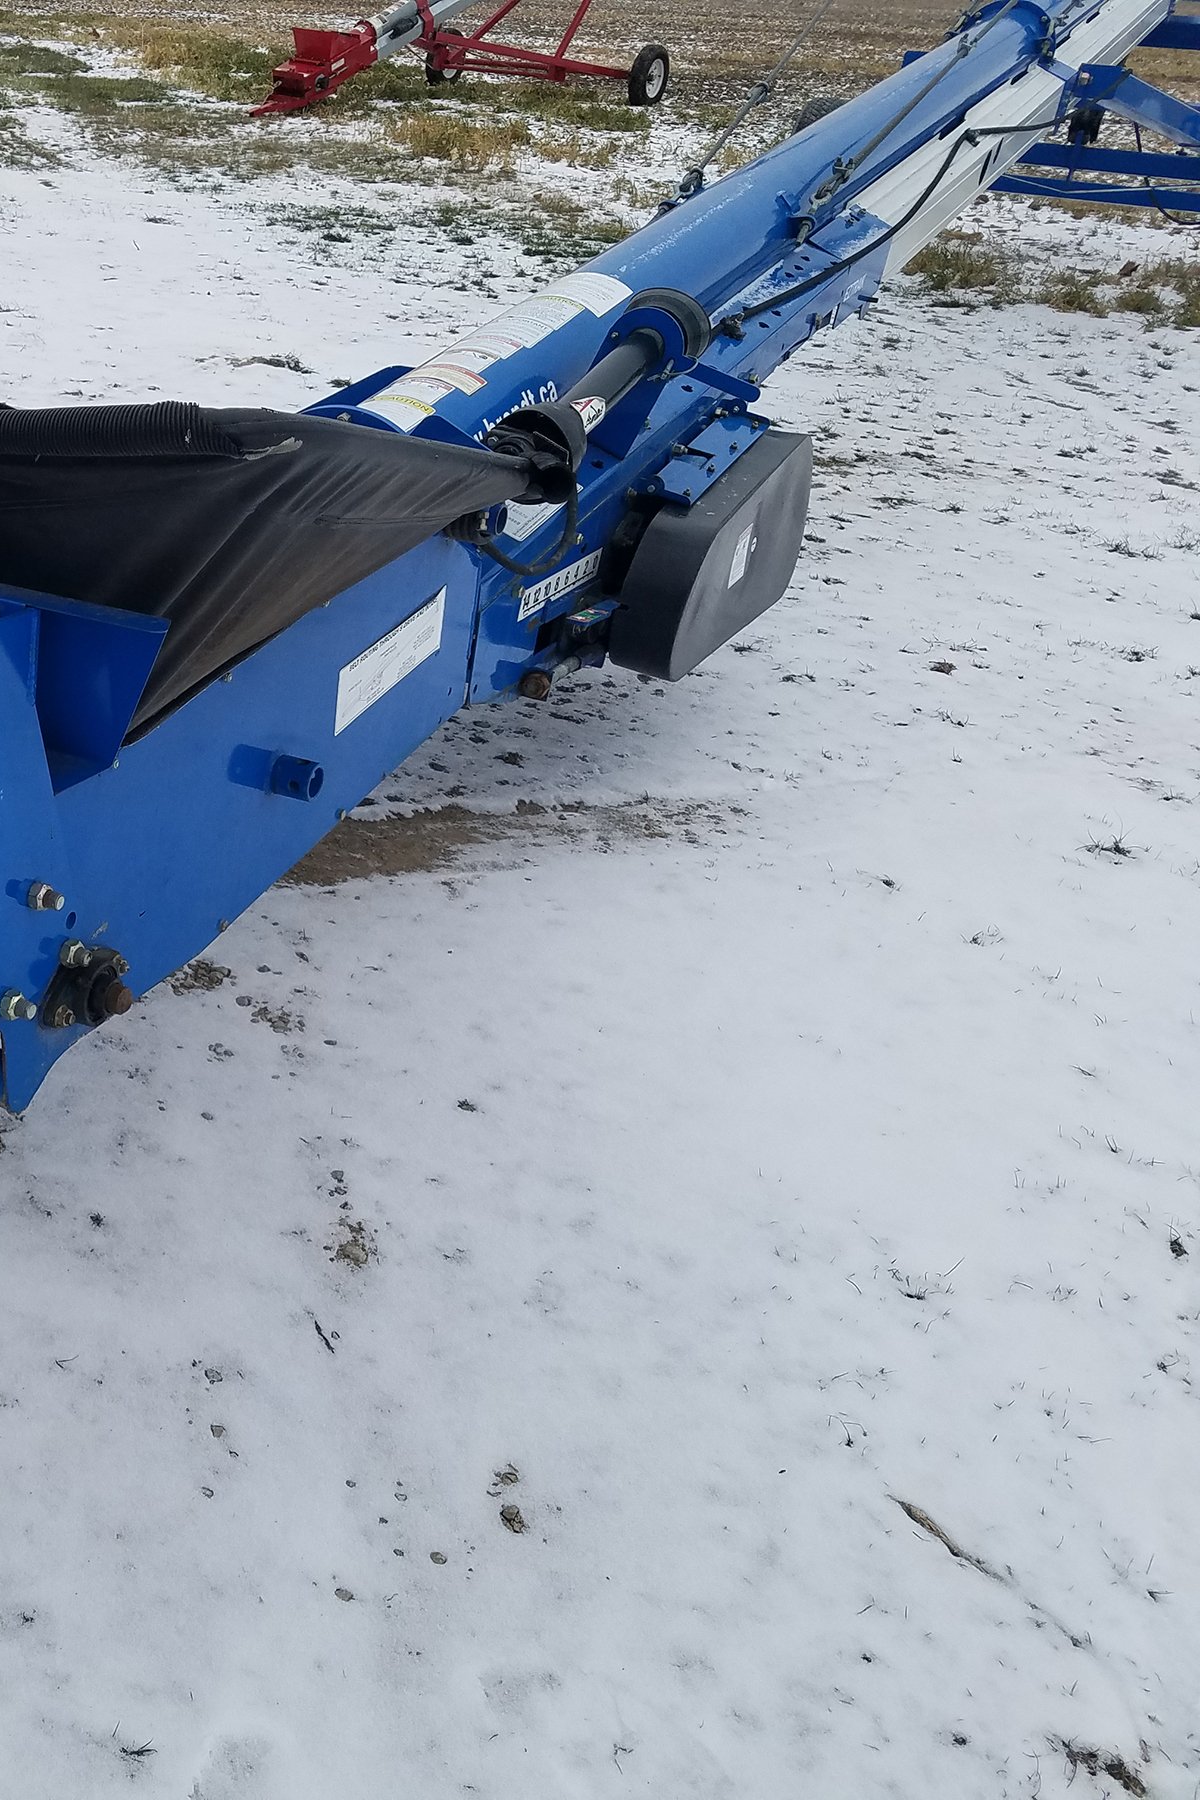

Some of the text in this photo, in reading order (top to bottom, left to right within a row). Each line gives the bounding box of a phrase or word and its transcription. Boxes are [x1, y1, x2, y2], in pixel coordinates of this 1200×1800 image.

[384, 396, 429, 412] AUTION
[523, 554, 599, 610] 14 12 10 8 6 4 2 0
